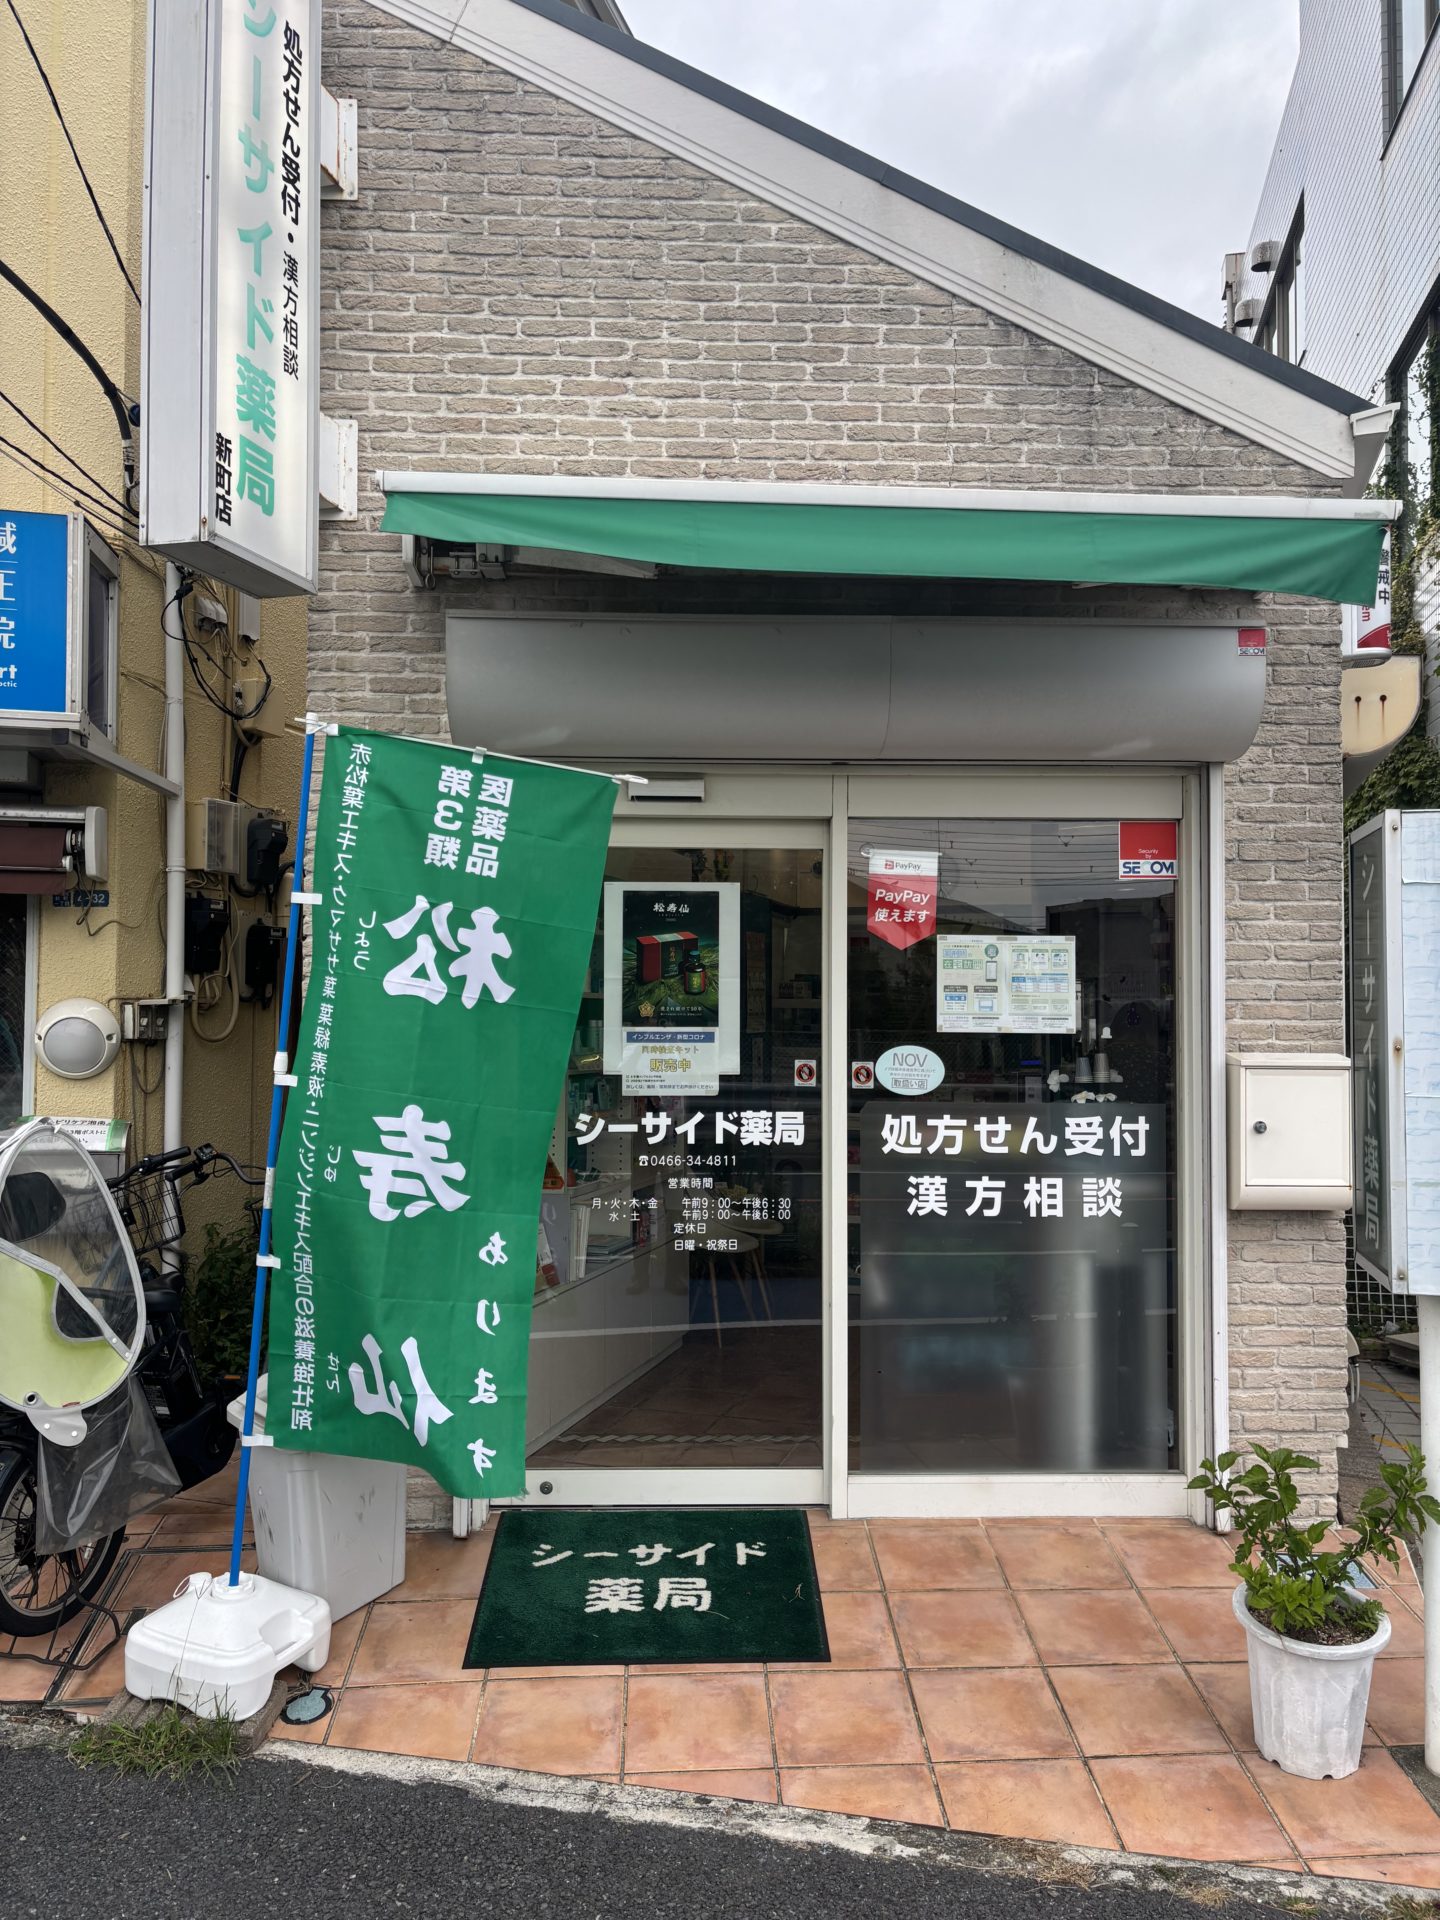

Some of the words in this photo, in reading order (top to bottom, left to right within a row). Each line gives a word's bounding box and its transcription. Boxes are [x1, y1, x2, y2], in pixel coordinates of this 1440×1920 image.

[215, 432, 232, 526] 新町店
[895, 862, 921, 870] PayPay
[1122, 861, 1174, 875] SECOM
[875, 888, 930, 905] PayPay
[653, 902, 690, 913] 松寿仙
[875, 907, 930, 923] 使えます
[1362, 853, 1380, 1251] シーサイド薬局
[650, 1058, 692, 1073] 販売中
[892, 1052, 928, 1068] NOV
[575, 1110, 805, 1146] シーサイド薬局
[881, 1114, 1150, 1157] 処方せん受付
[650, 1155, 737, 1166] 0466-34-4811
[667, 1178, 713, 1189] 営業時間
[591, 1198, 659, 1209] 月・火・木・金
[906, 1175, 1123, 1219] 漢方相談
[608, 1211, 641, 1222] 水・土
[673, 1223, 707, 1234] 定休日
[674, 1239, 738, 1251] 日曜・祝祭日
[531, 1542, 767, 1567] シーサイド
[584, 1577, 712, 1613] 薬局
